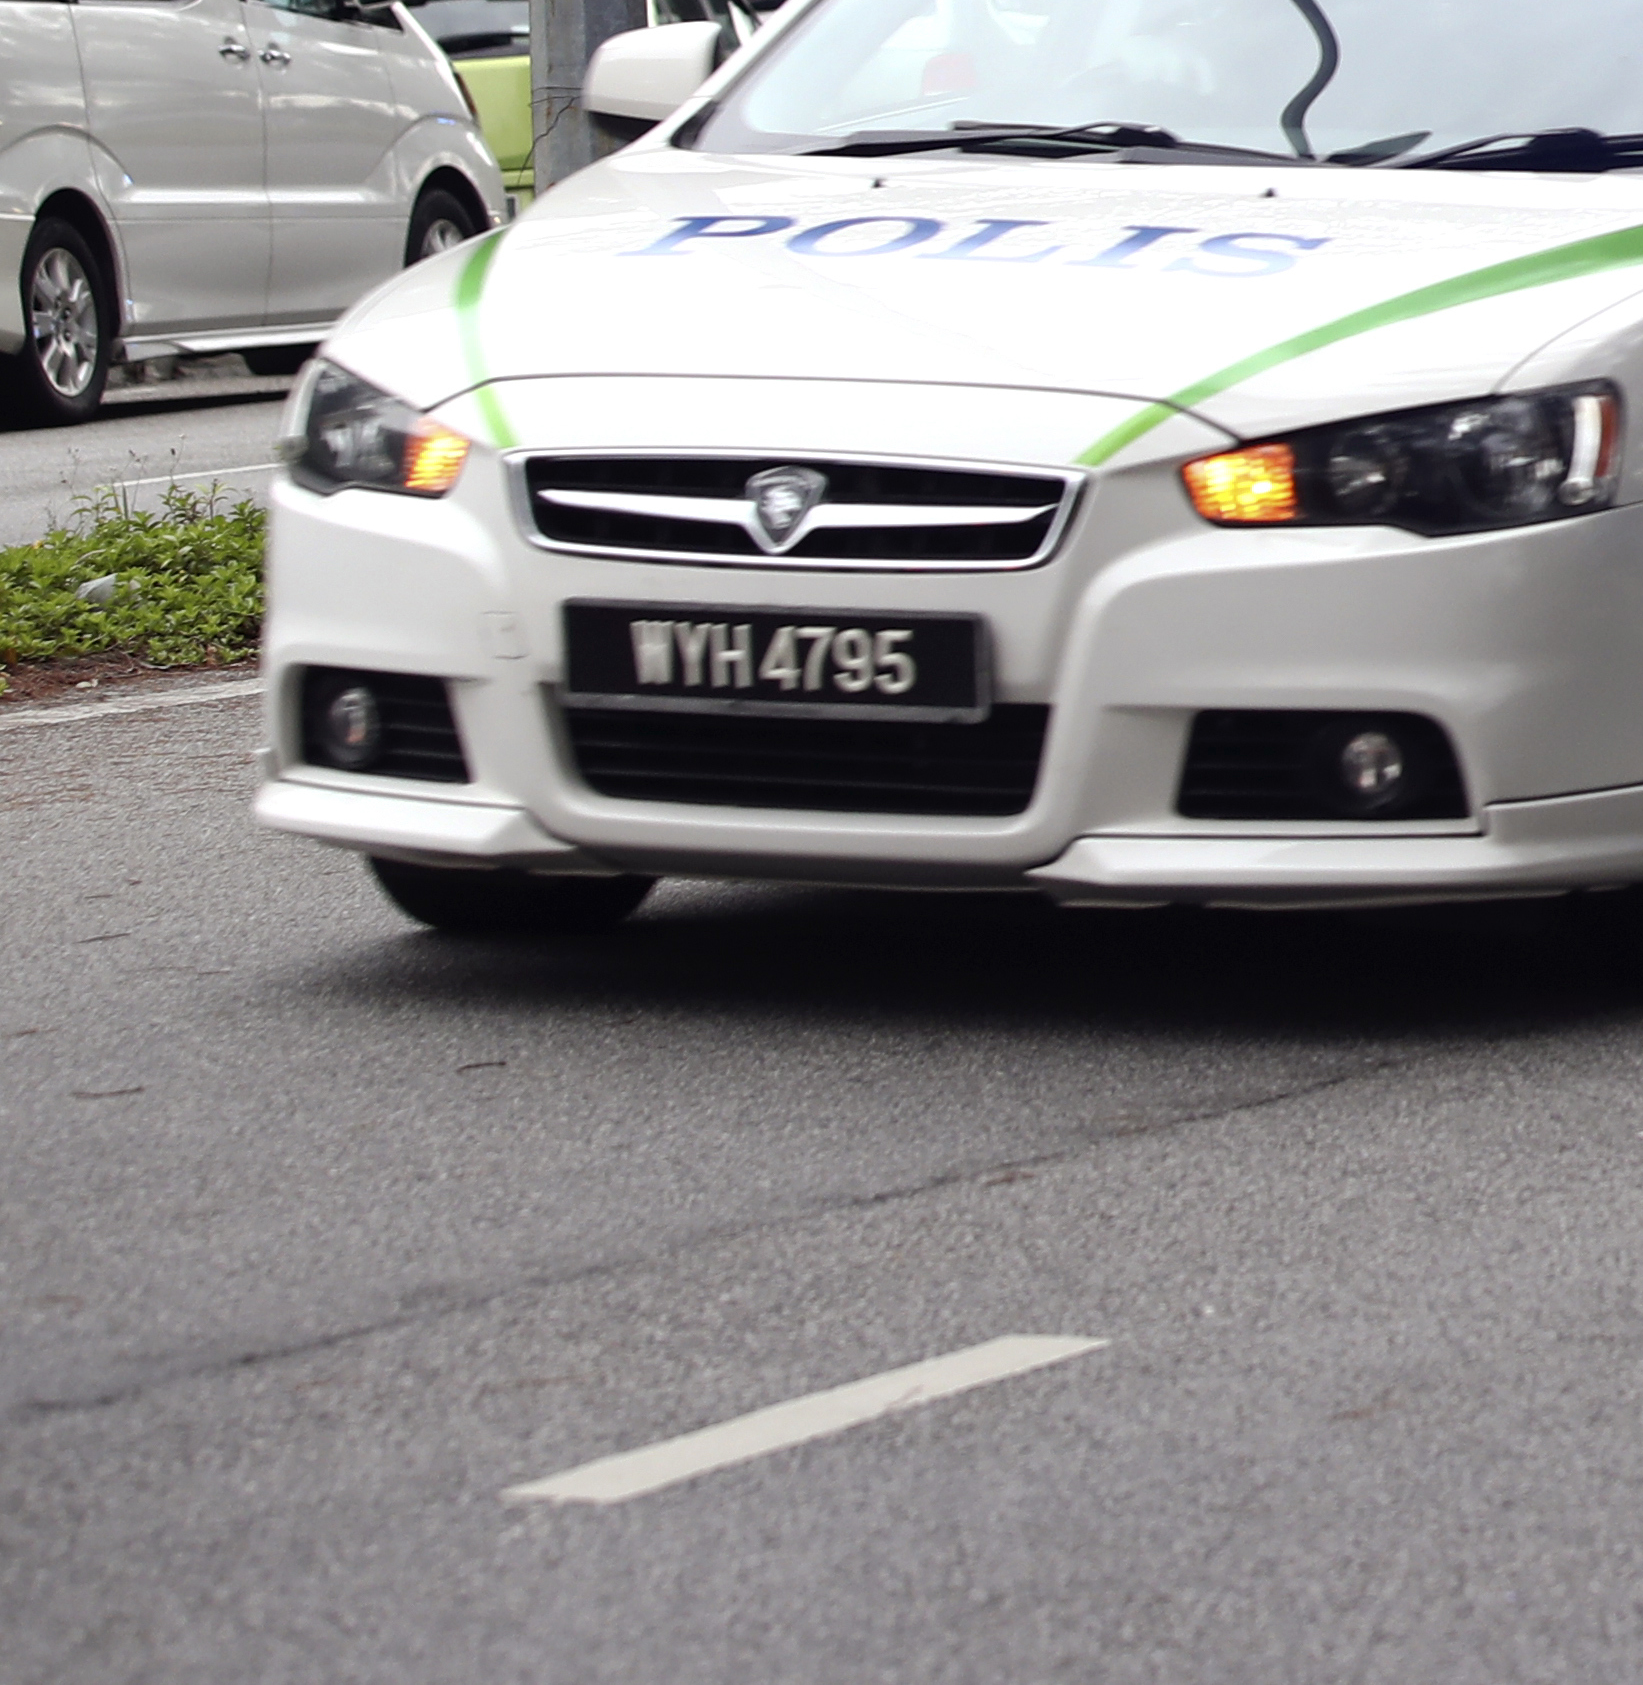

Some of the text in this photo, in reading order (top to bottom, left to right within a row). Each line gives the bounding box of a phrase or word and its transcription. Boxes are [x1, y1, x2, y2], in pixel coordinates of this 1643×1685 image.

[614, 215, 1333, 278] POLIS
[630, 620, 916, 695] WYH 4795
